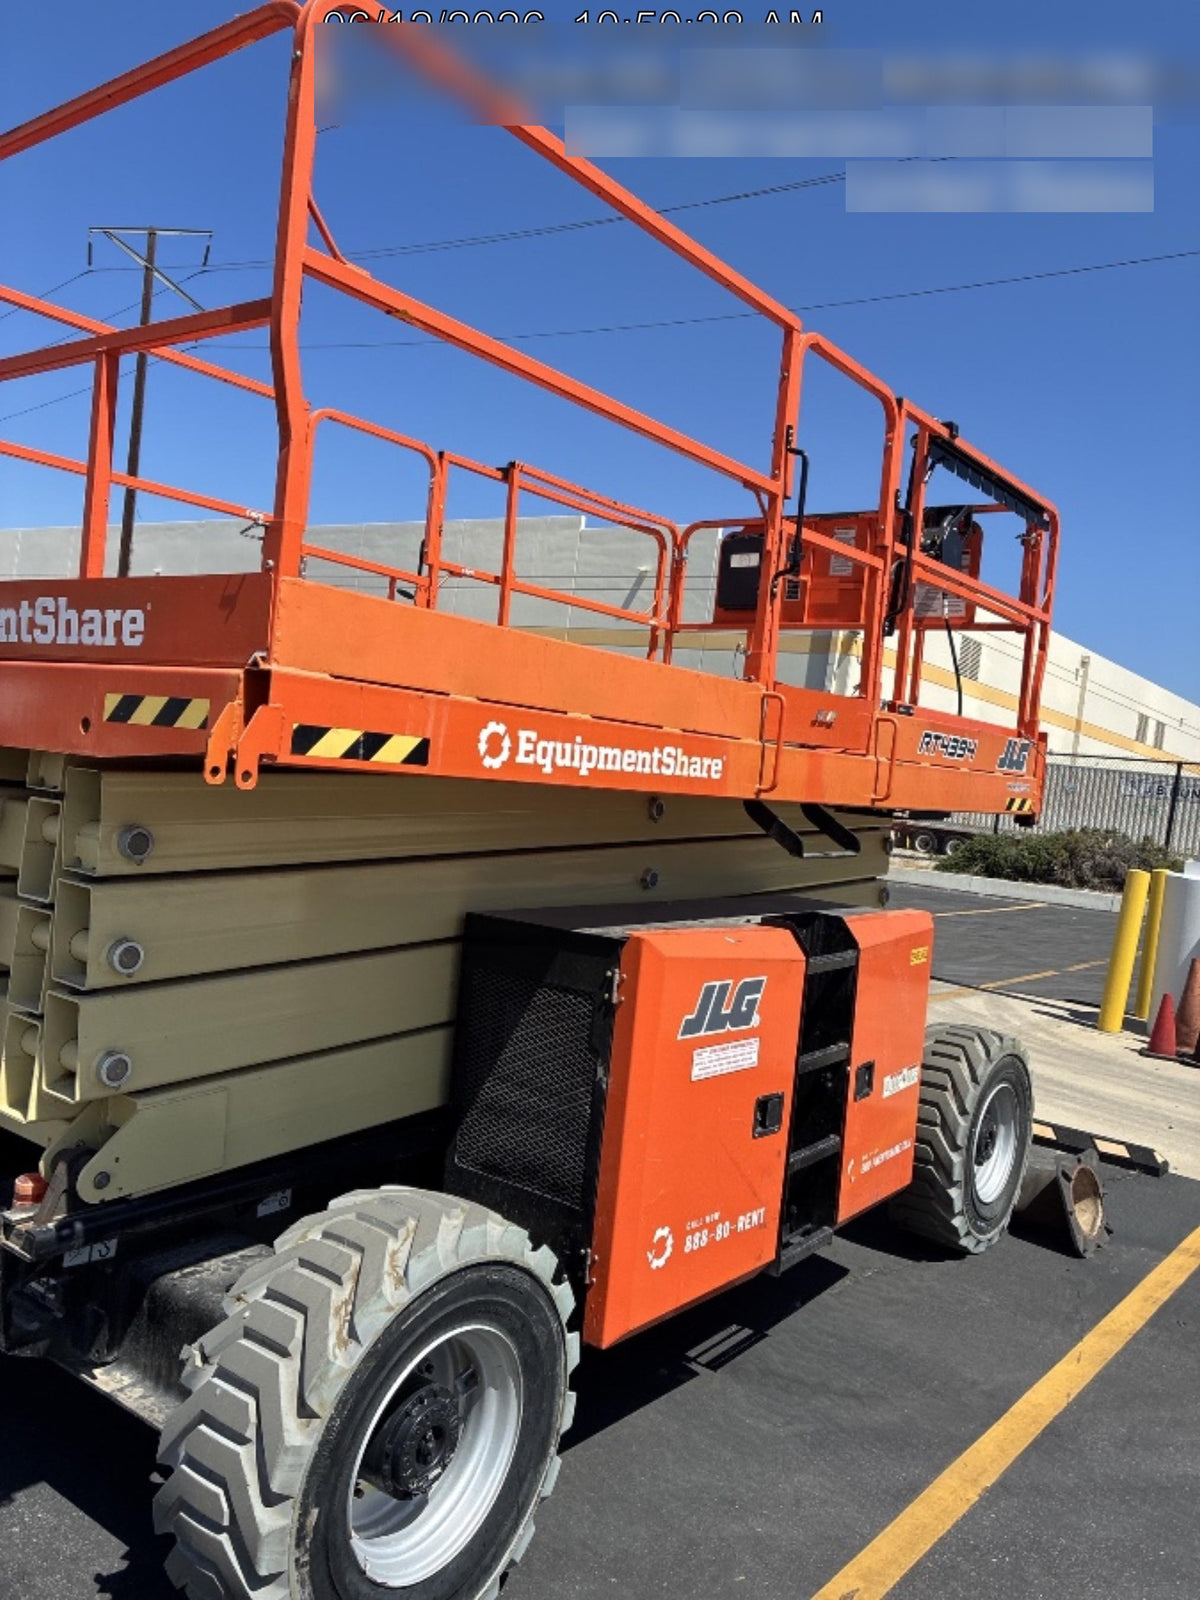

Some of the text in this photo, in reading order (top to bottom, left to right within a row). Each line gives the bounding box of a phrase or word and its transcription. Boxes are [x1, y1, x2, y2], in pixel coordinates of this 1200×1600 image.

[515, 729, 723, 780] EquipmentShare
[917, 730, 978, 762] RT4394
[677, 976, 768, 1040] JLG
[683, 1206, 766, 1254] 888-80-RENT
